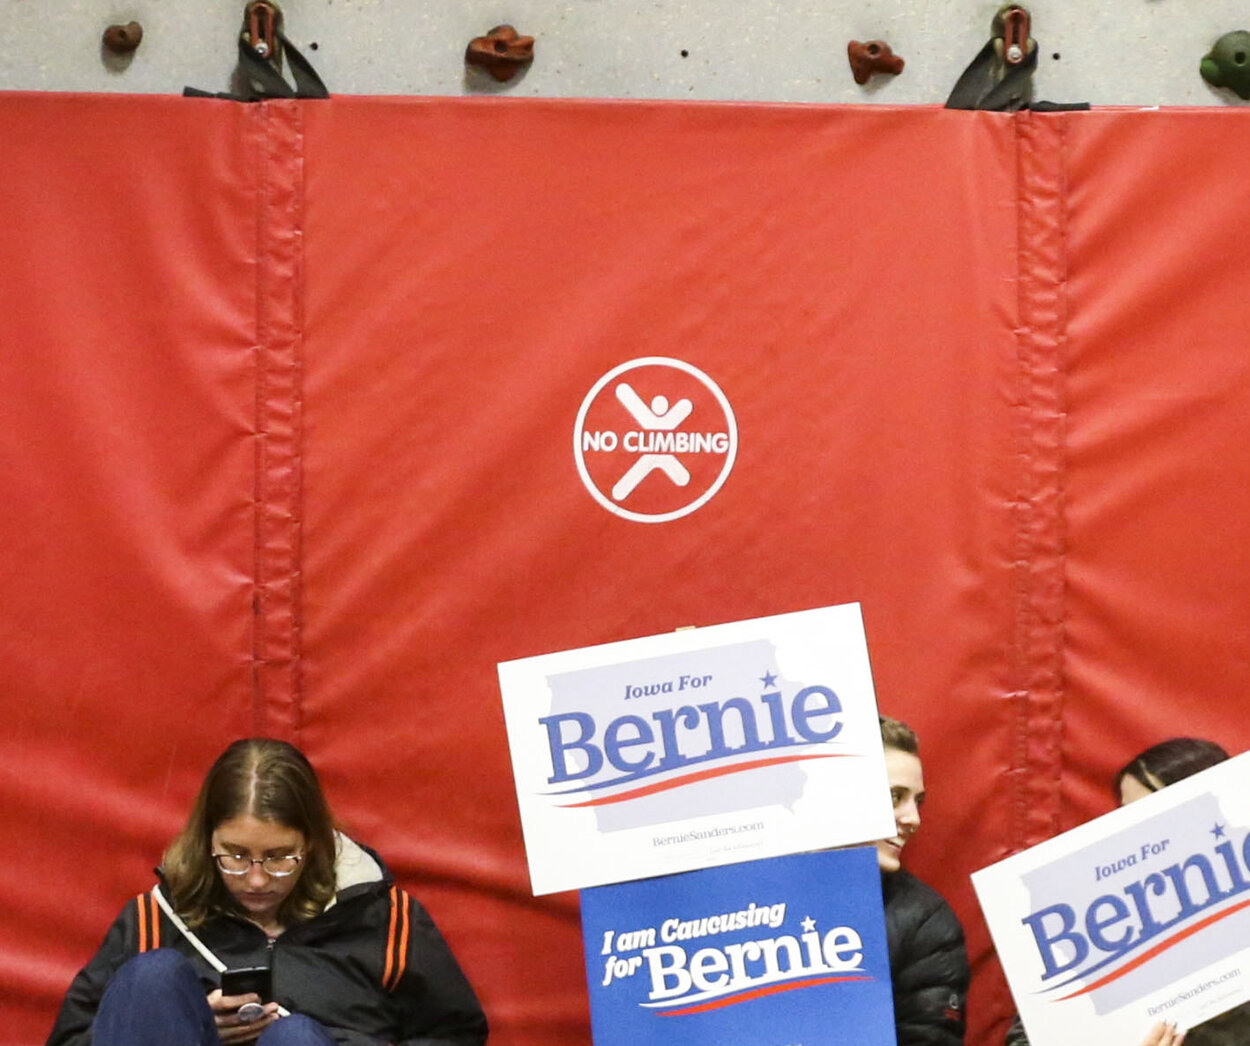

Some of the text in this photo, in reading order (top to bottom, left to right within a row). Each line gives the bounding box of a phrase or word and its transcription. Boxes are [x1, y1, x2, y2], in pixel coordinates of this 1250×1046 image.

[583, 430, 729, 454] NO CLIMBING
[624, 674, 713, 700] Iowa For
[539, 669, 844, 785] Bernie
[652, 821, 765, 847] BernieSanders.com
[1094, 837, 1171, 881] Iowa For
[601, 903, 787, 955] I am Caucusing
[602, 955, 643, 986] for
[642, 915, 864, 1000] Bernie
[1147, 967, 1242, 1017] BernieSanders.com
